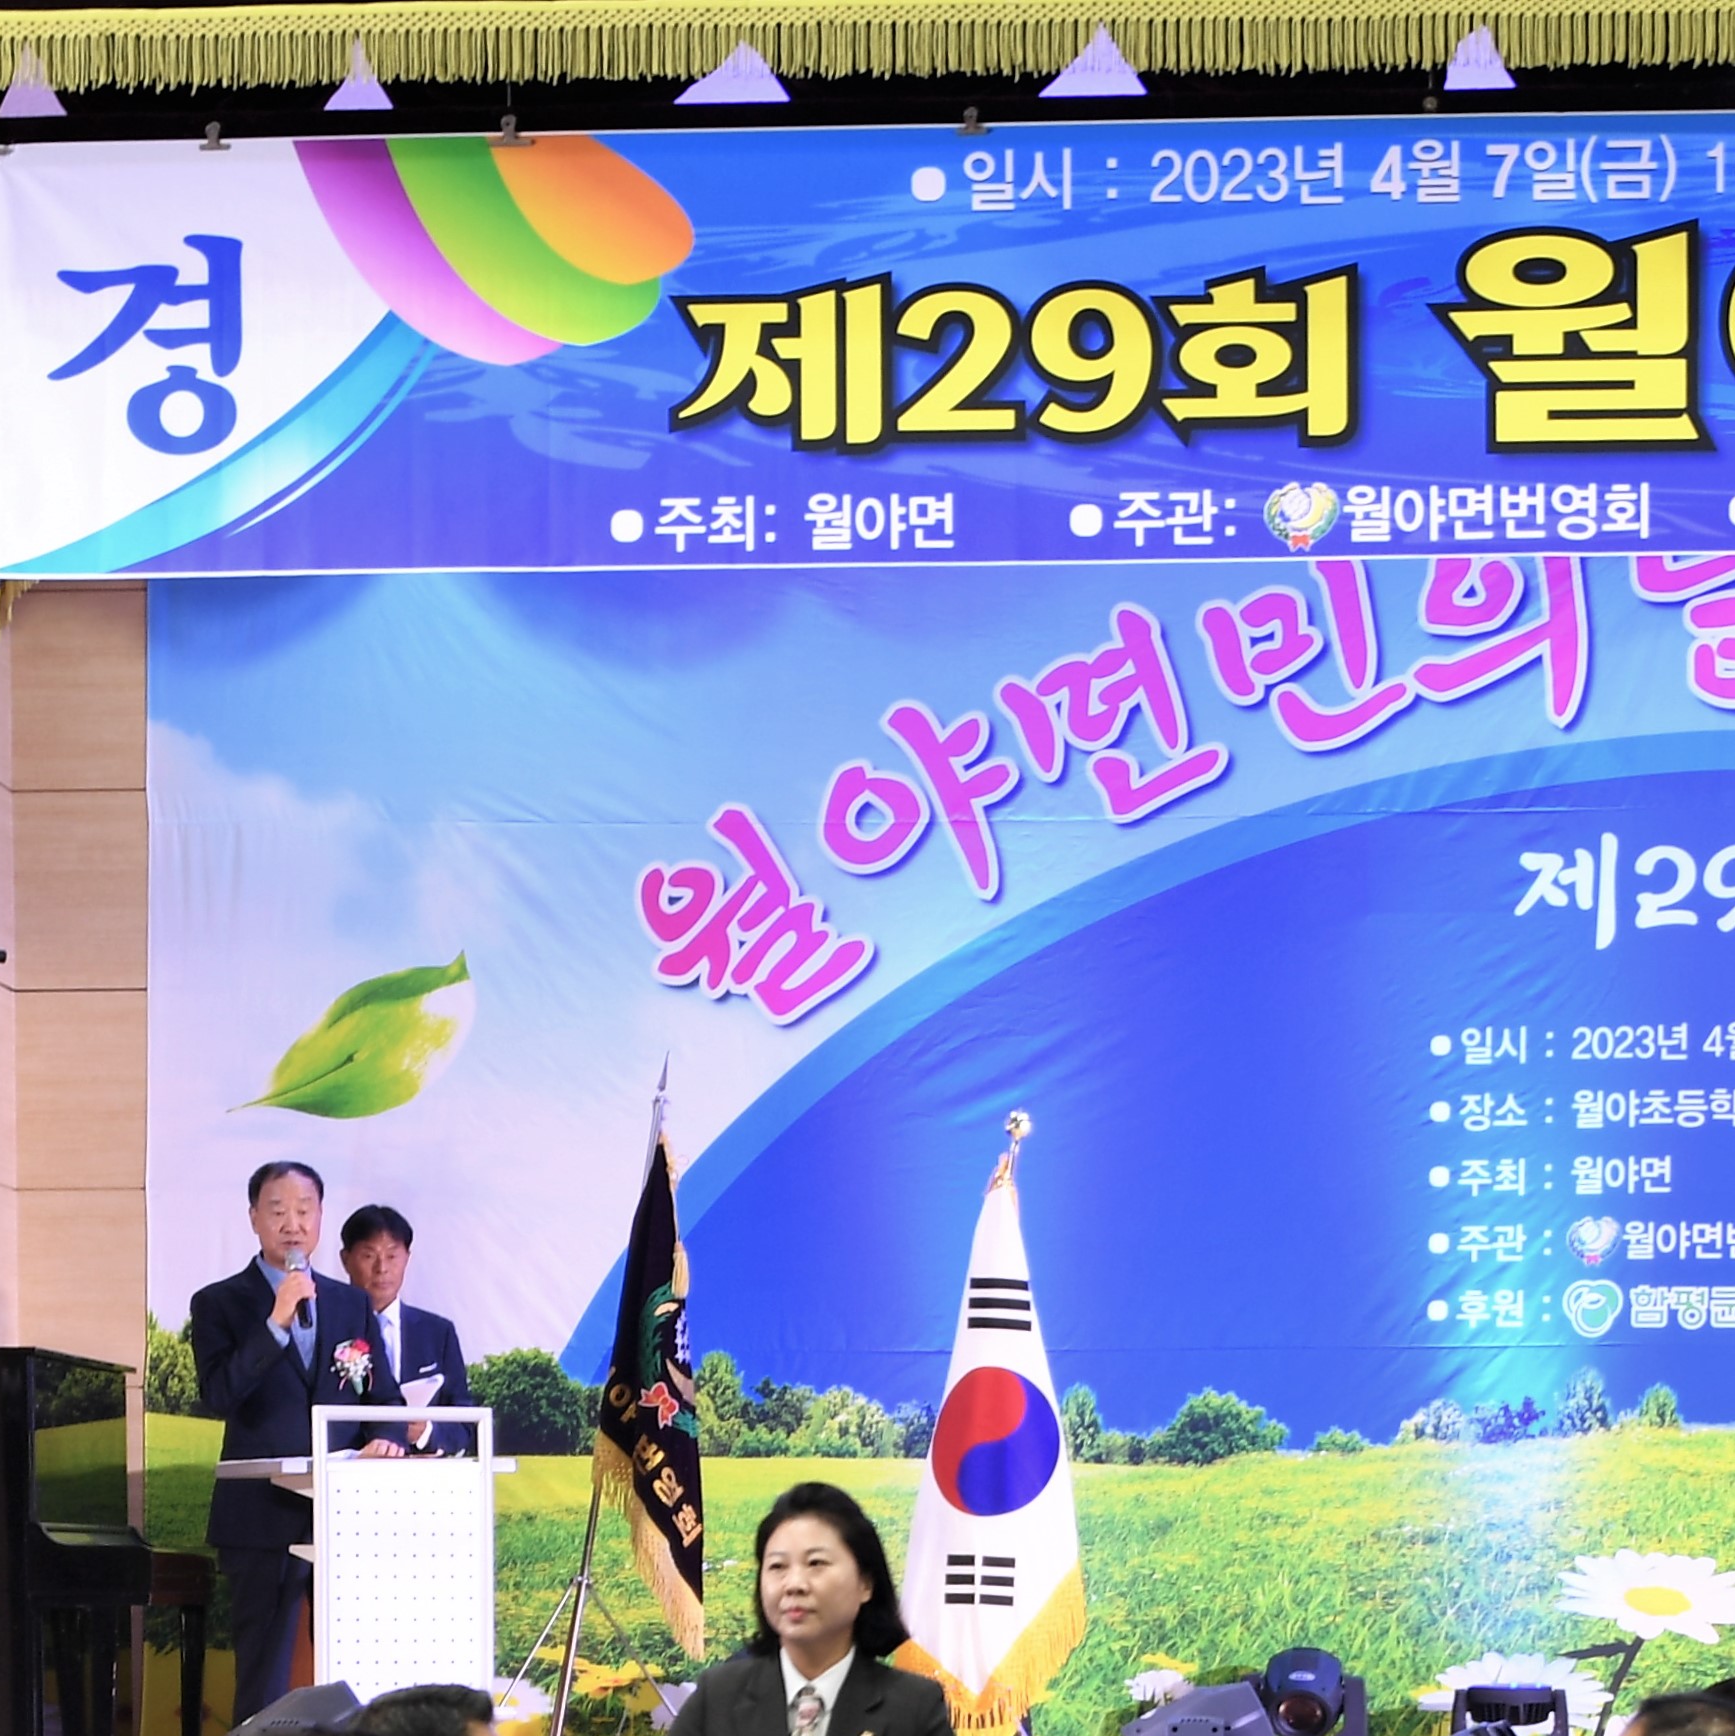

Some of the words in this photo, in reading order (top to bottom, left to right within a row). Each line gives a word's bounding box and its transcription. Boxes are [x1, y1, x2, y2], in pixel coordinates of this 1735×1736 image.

[963, 149, 1072, 212] 일시
[1150, 143, 1344, 204] 2023년
[1370, 140, 1461, 203] 4월
[1486, 135, 1676, 203] 7일(금)
[47, 234, 243, 455] 경
[672, 265, 1357, 449] 제29회
[653, 494, 777, 554] 주최:
[802, 491, 956, 552] 월야면
[1112, 487, 1237, 548] 주관:
[1341, 481, 1651, 544] 월야면번영회
[1460, 1025, 1527, 1066] 일시
[1571, 1022, 1688, 1061] 2023년
[1459, 1092, 1529, 1132] 장소
[1457, 1157, 1526, 1197] 주최
[1570, 1155, 1672, 1194] 월야면
[1456, 1223, 1528, 1263] 주관
[1455, 1288, 1525, 1329] 후원
